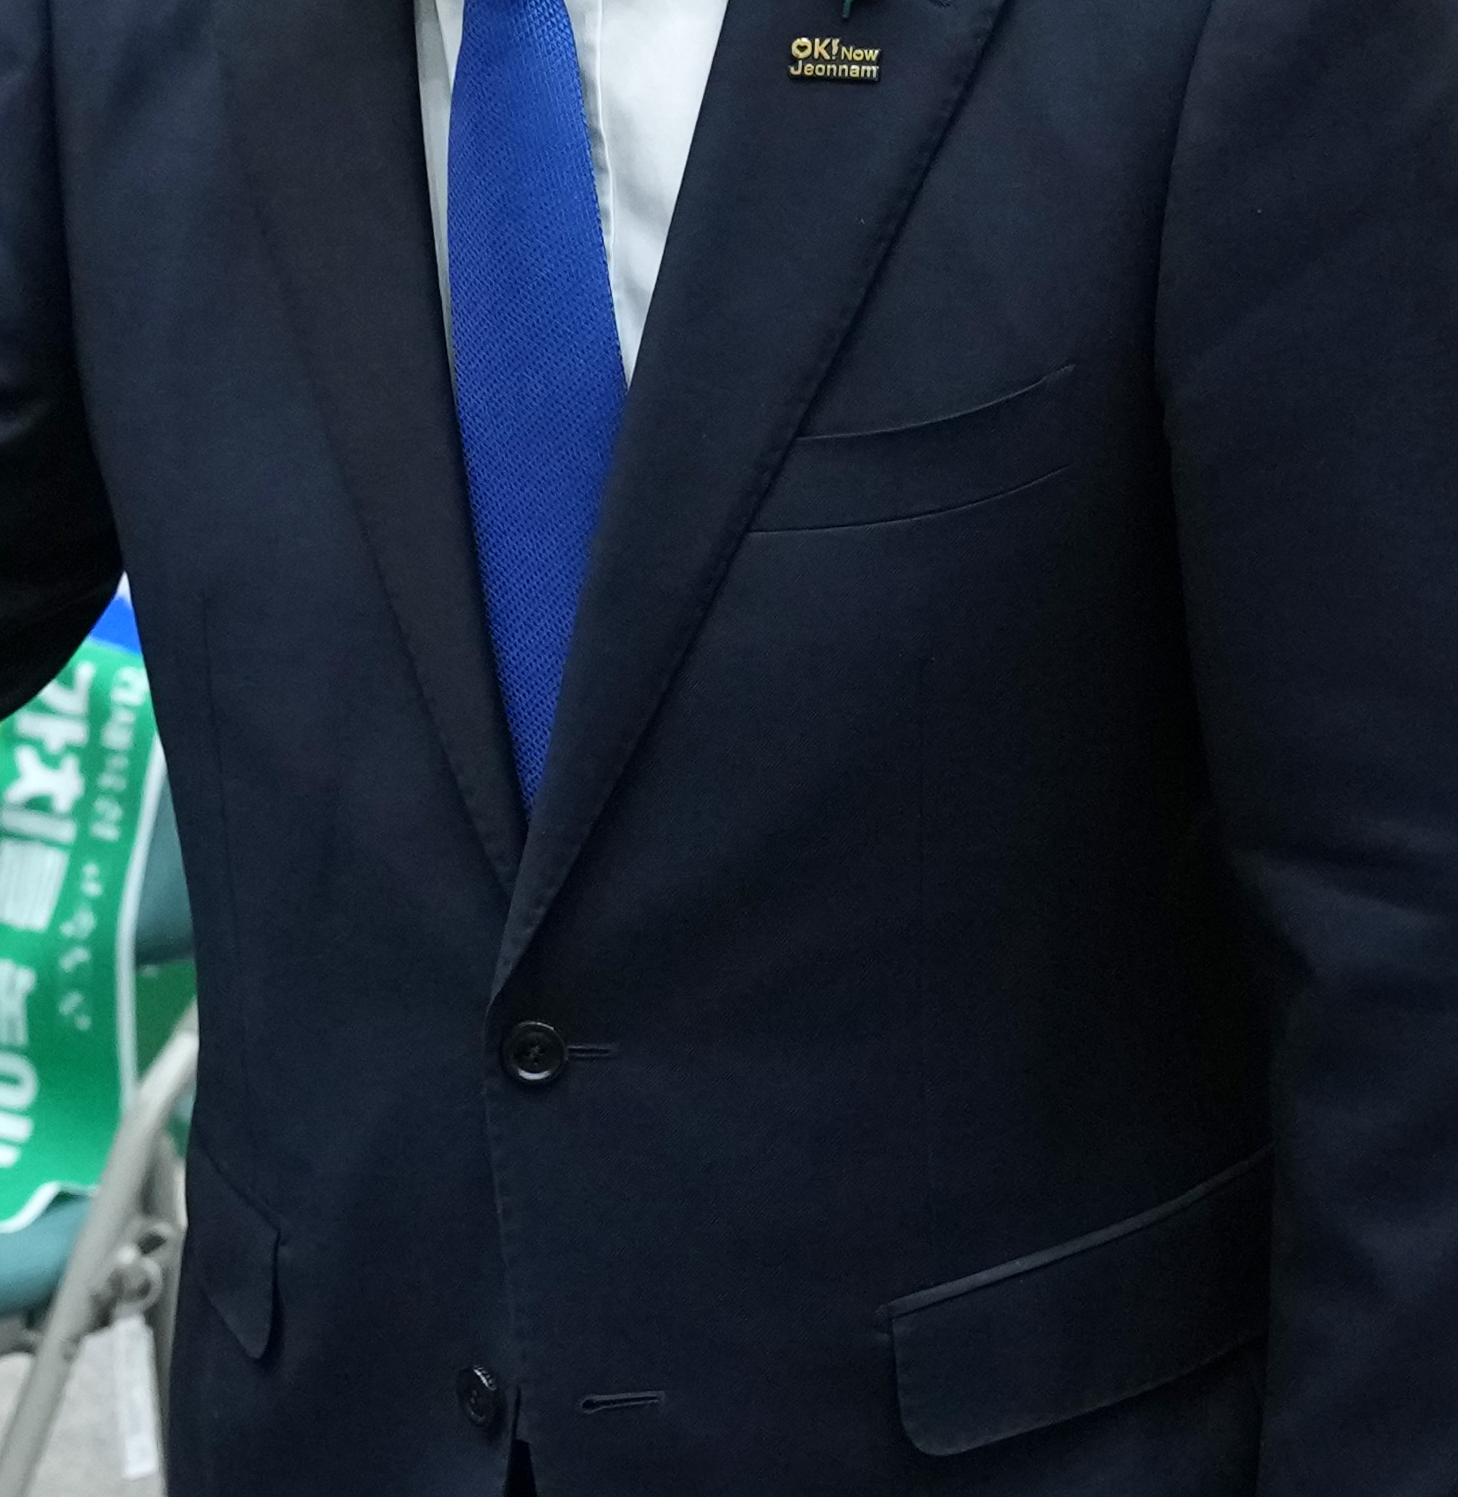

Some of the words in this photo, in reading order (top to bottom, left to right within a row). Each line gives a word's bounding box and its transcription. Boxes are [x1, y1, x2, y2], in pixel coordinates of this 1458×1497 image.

[790, 36, 841, 61] OK!
[841, 45, 881, 62] Now
[788, 59, 880, 79] Jeonnam
